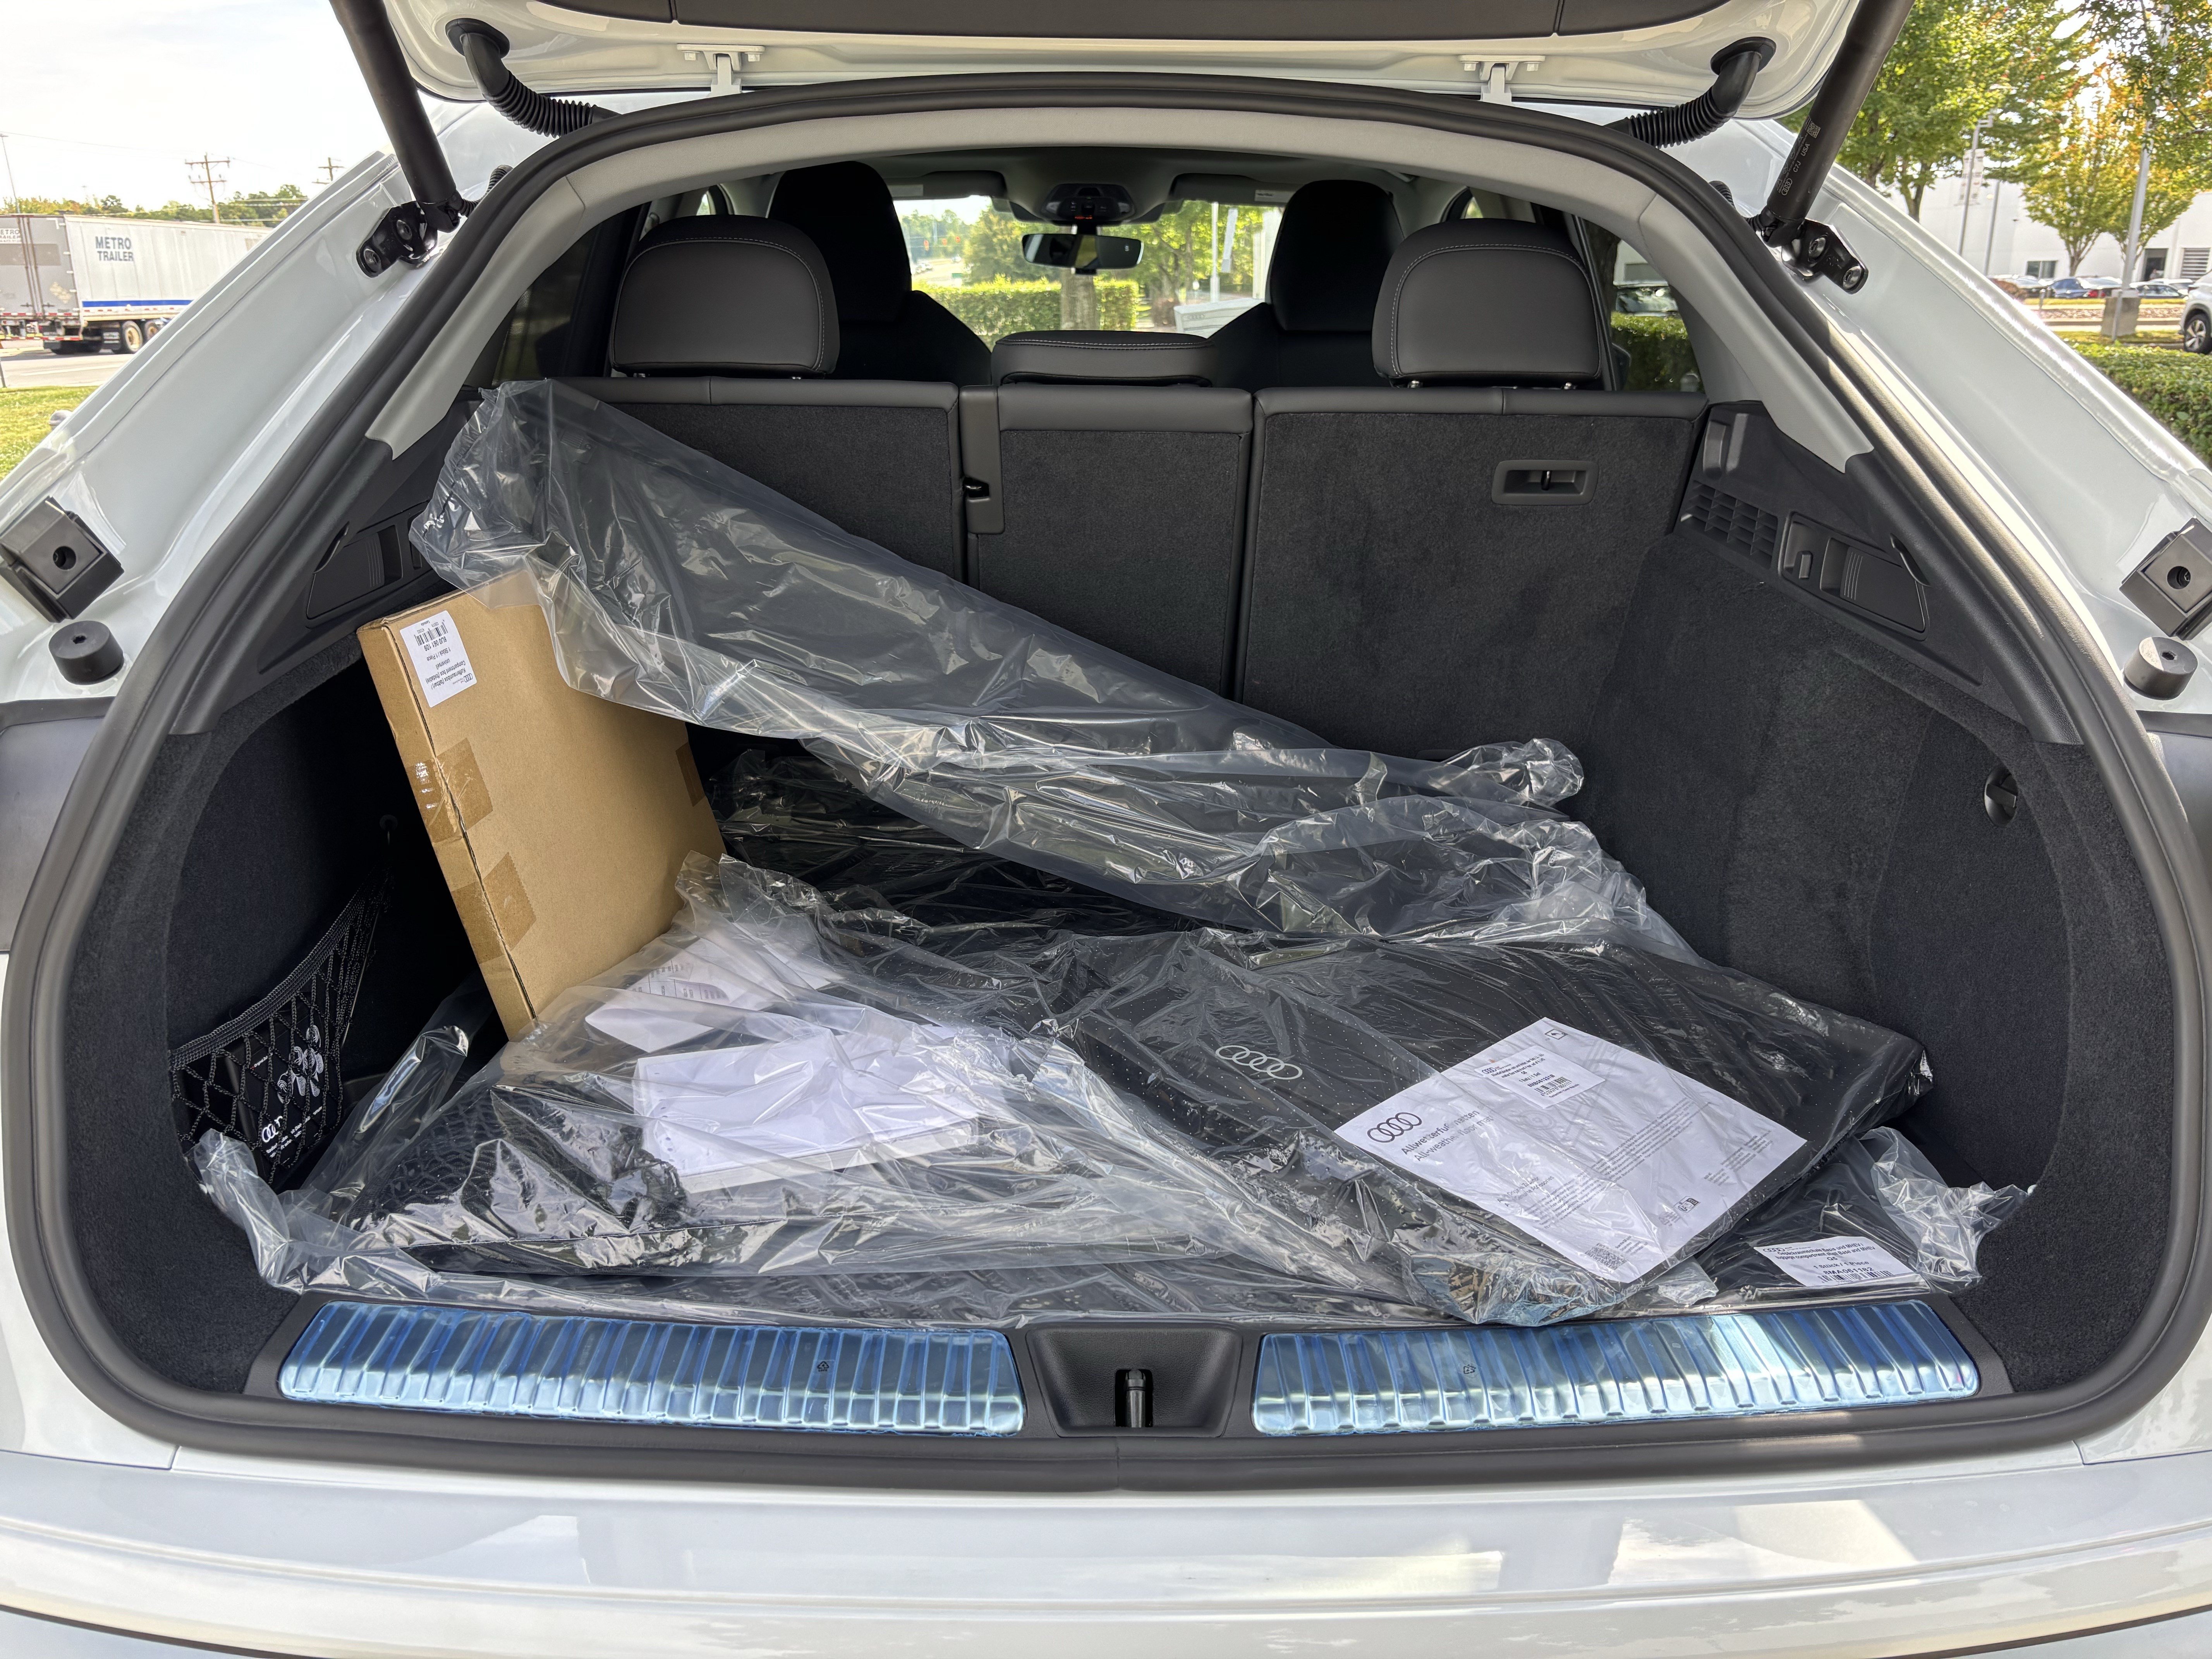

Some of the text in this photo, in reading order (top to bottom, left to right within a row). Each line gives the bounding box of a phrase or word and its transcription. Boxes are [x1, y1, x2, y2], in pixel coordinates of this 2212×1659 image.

[1793, 144, 1810, 172] C7J USA
[95, 236, 131, 250] METRO
[97, 251, 134, 261] TRAILER
[1414, 1133, 1458, 1161] All-weathe
